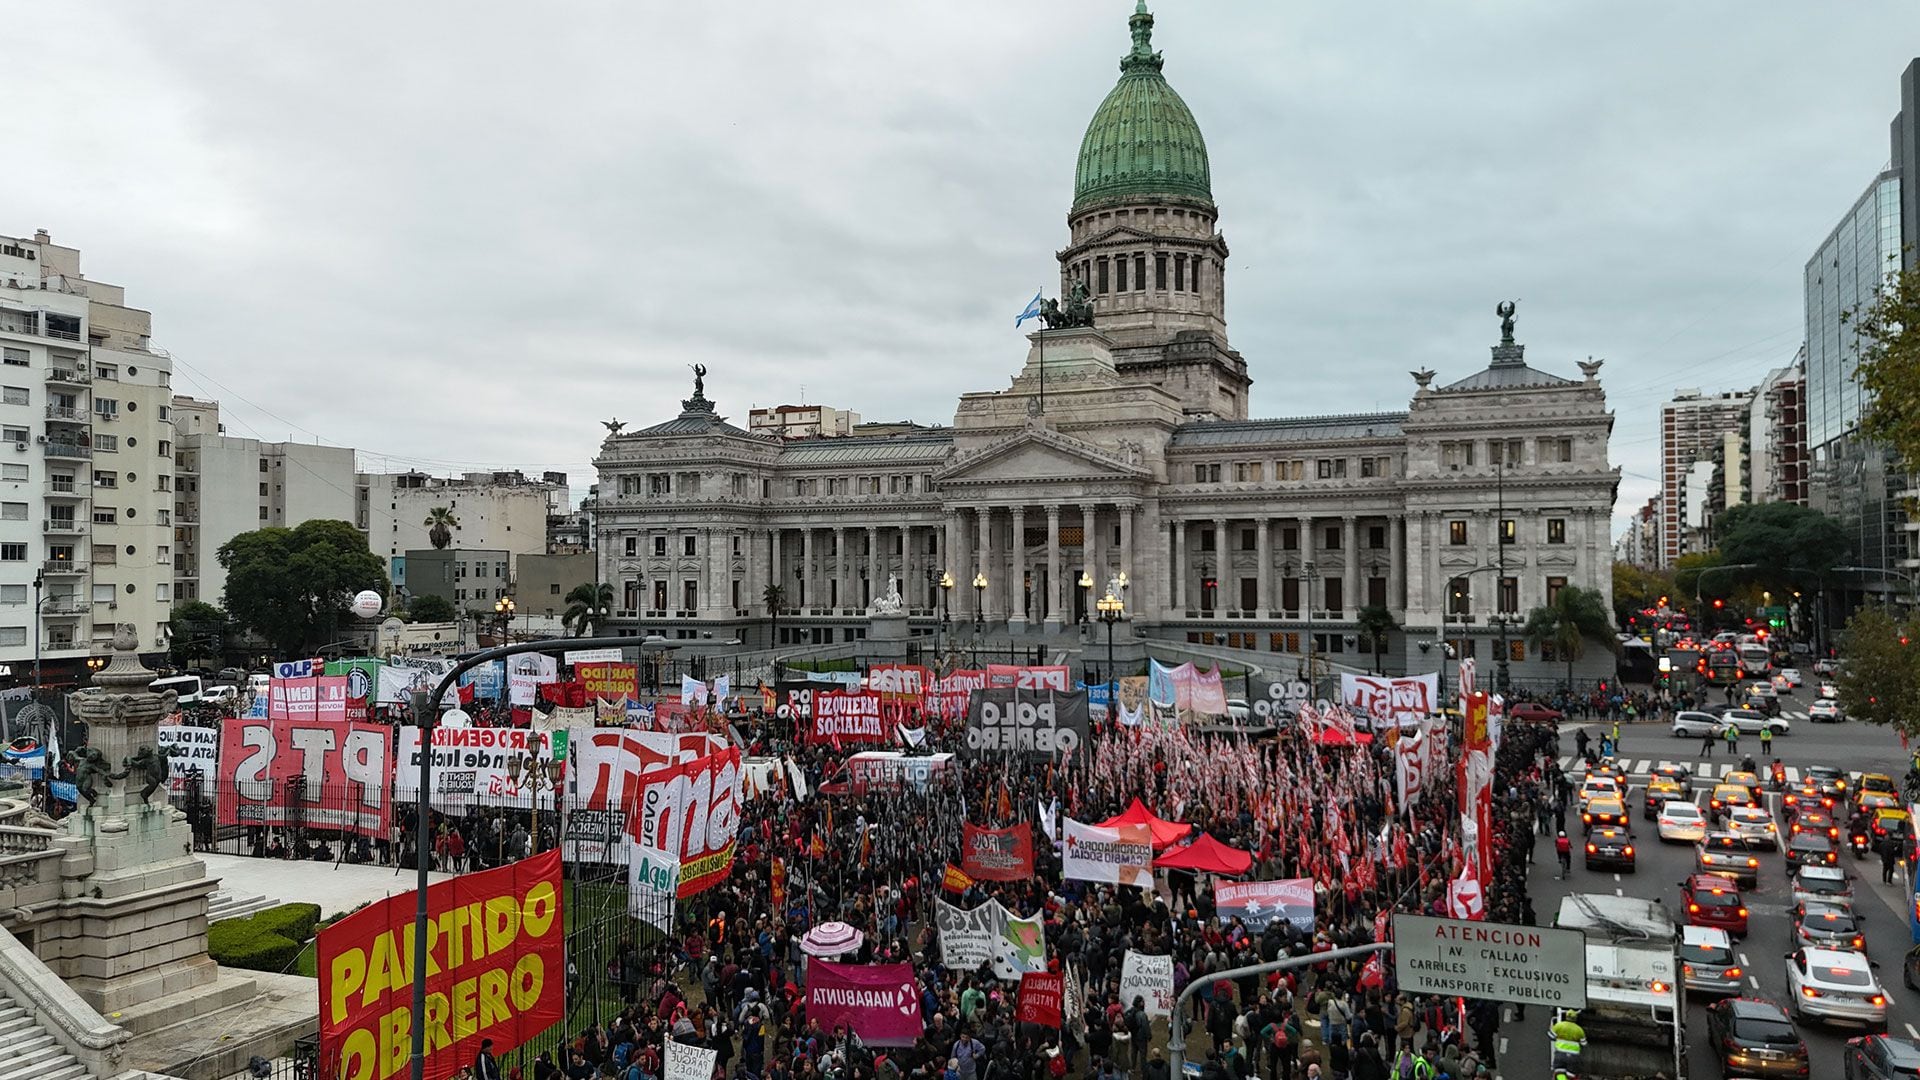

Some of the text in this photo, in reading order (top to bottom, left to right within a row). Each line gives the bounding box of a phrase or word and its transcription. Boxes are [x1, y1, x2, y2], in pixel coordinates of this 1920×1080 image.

[280, 661, 311, 679] OLP
[818, 696, 879, 715] IZQUIERDA
[817, 716, 882, 736] SOCIALISTA
[643, 789, 659, 848] uevo
[1435, 925, 1541, 947] ATENCION
[330, 880, 557, 1025] PARTIDO
[1480, 949, 1528, 963] CALLAO
[1410, 959, 1569, 984] CARRILES EXCLUSIVOS
[1419, 976, 1561, 1000] TRANSPORTE PUBLICO
[339, 953, 544, 1080] OBRERO
